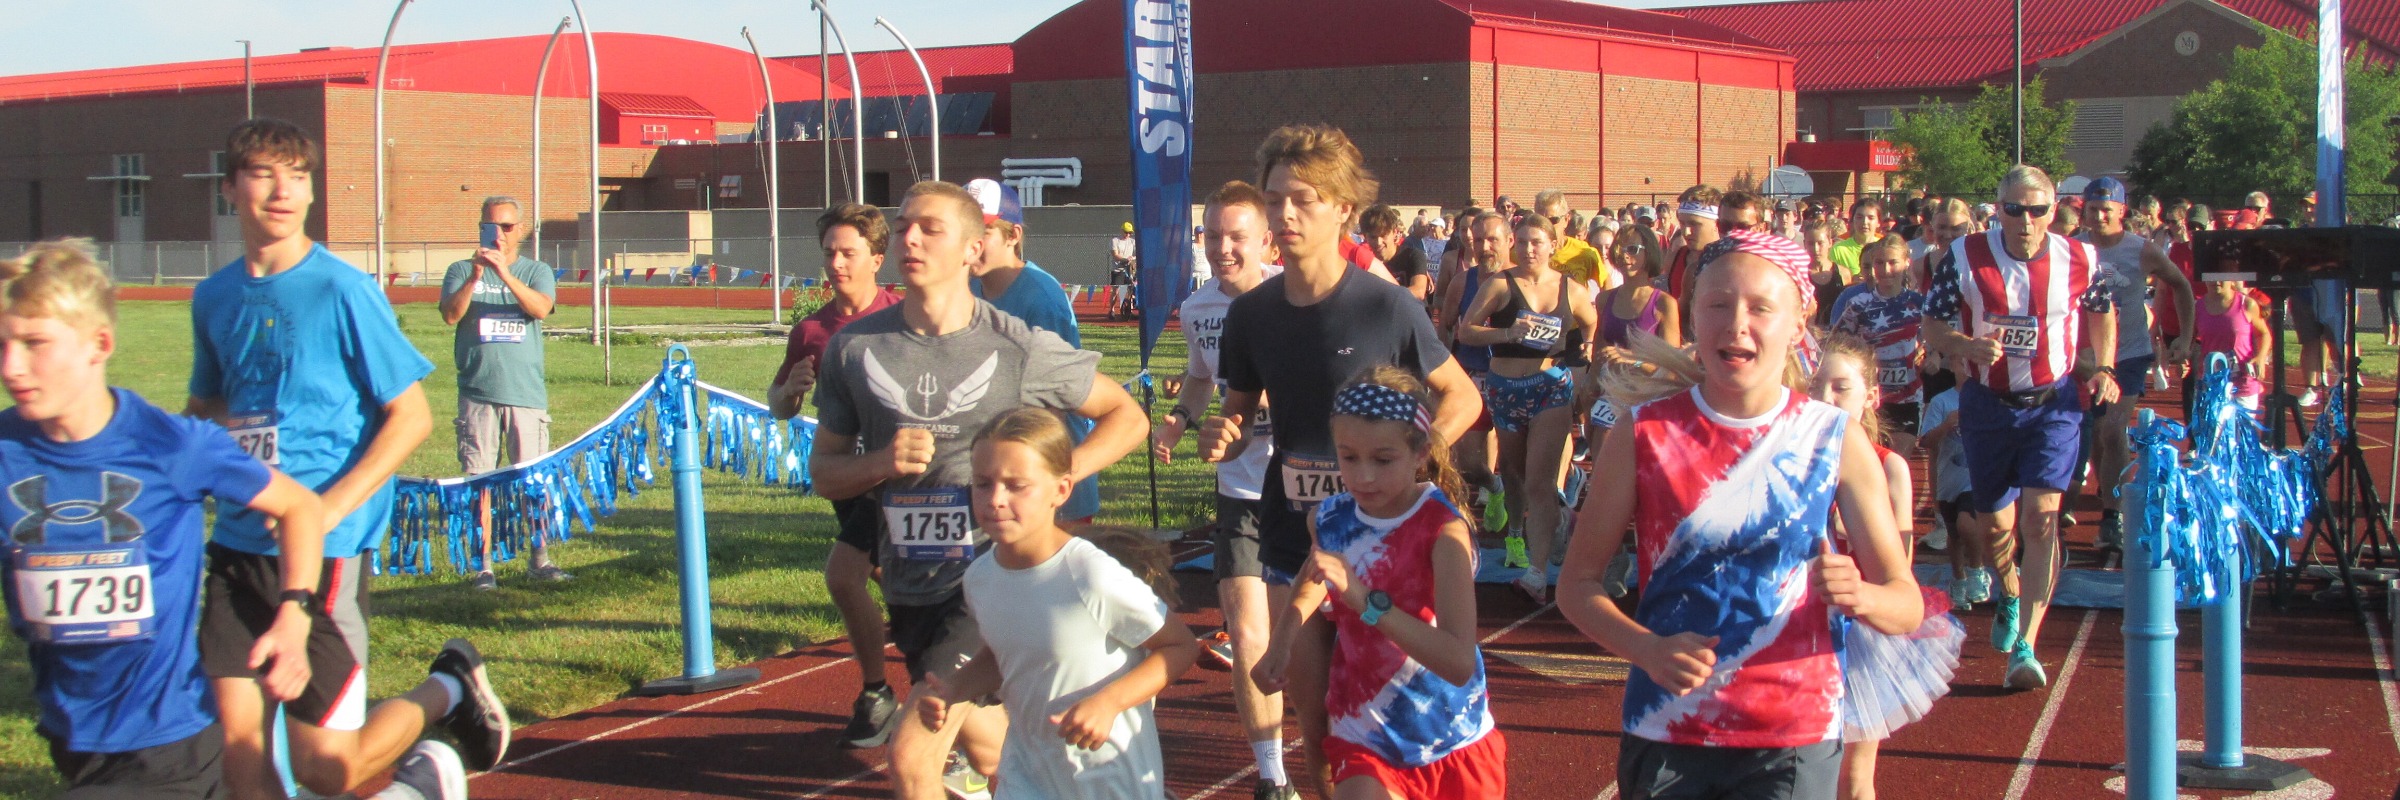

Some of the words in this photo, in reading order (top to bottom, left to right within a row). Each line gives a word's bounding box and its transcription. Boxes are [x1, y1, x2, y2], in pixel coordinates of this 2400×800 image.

[490, 320, 525, 334] 1566
[1525, 324, 1559, 343] 622
[2001, 328, 2037, 347] 652
[1879, 369, 1907, 383] 712
[892, 495, 928, 504] SPEEDY
[928, 494, 955, 504] FEET
[903, 511, 967, 541] 1753
[86, 551, 129, 566] FEET
[44, 574, 146, 617] 1739
